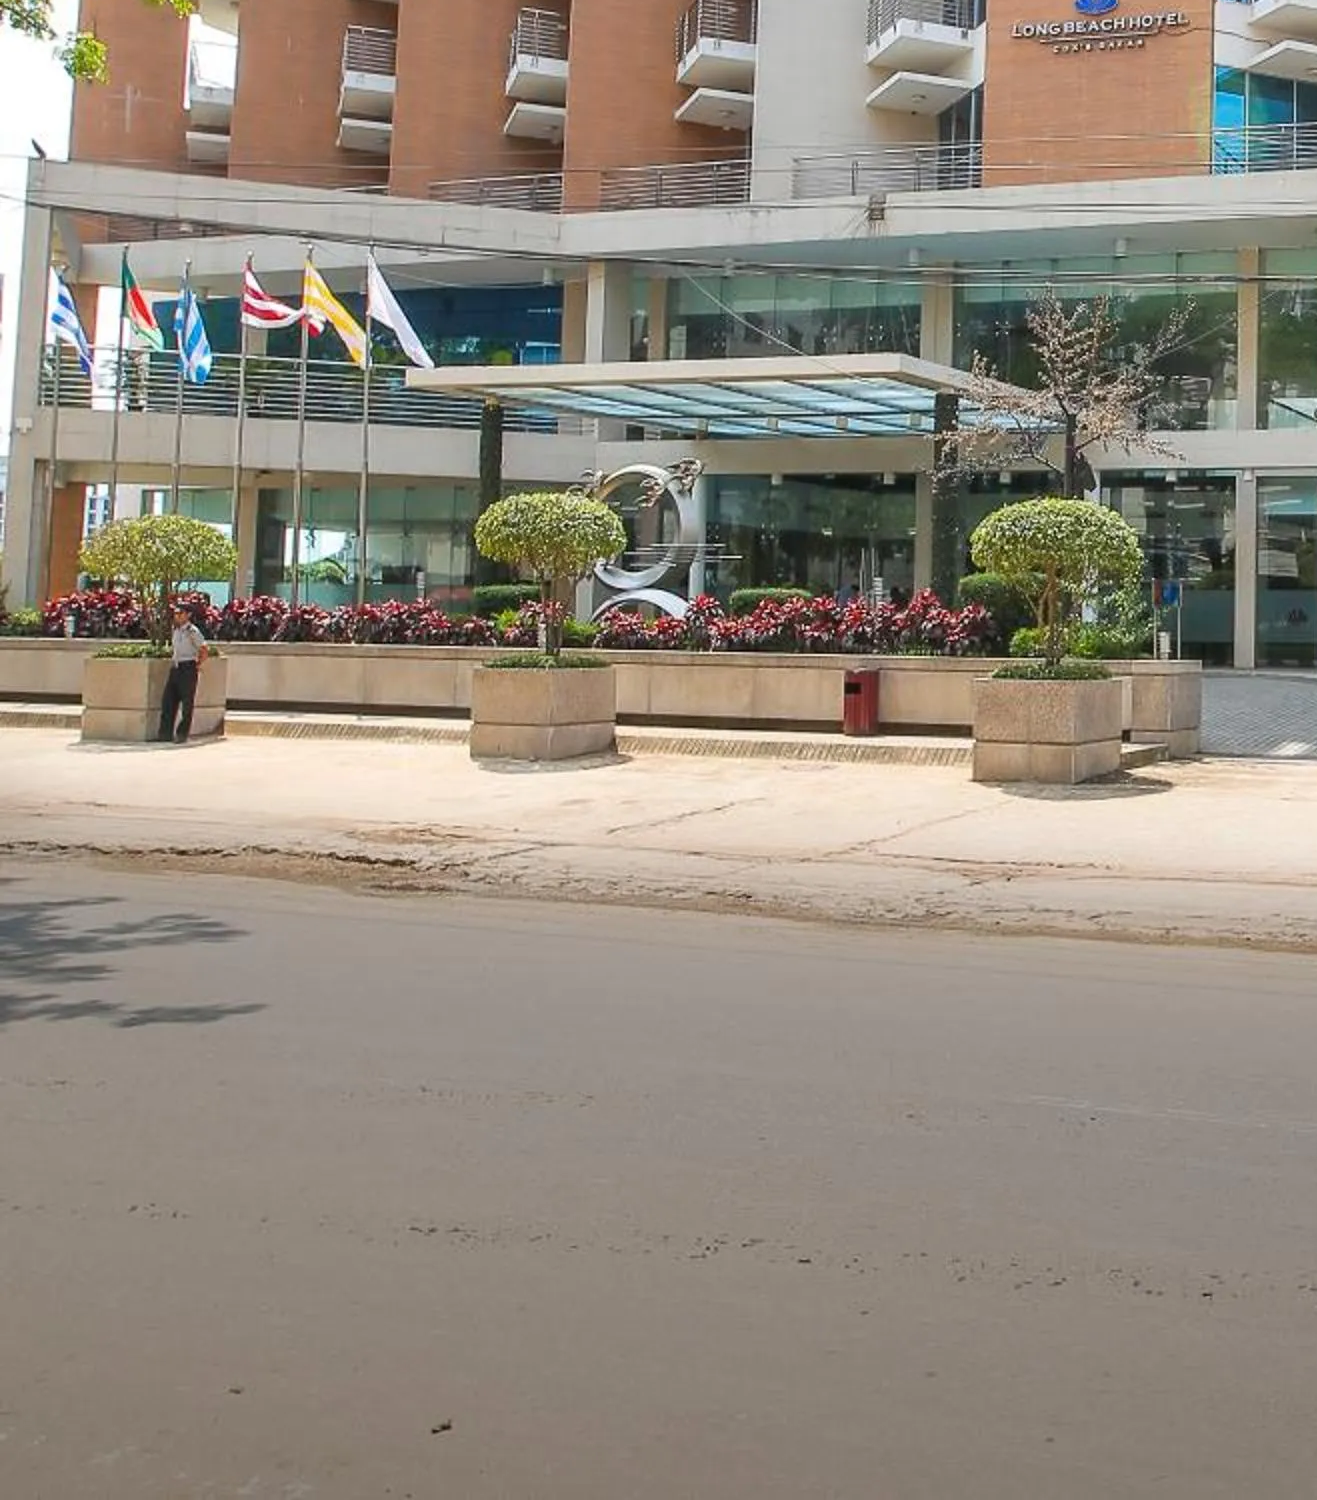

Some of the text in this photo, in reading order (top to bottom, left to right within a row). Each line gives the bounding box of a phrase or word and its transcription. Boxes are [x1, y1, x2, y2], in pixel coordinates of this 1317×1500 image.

[1012, 12, 1188, 38] LONG BEACH HOTEL
